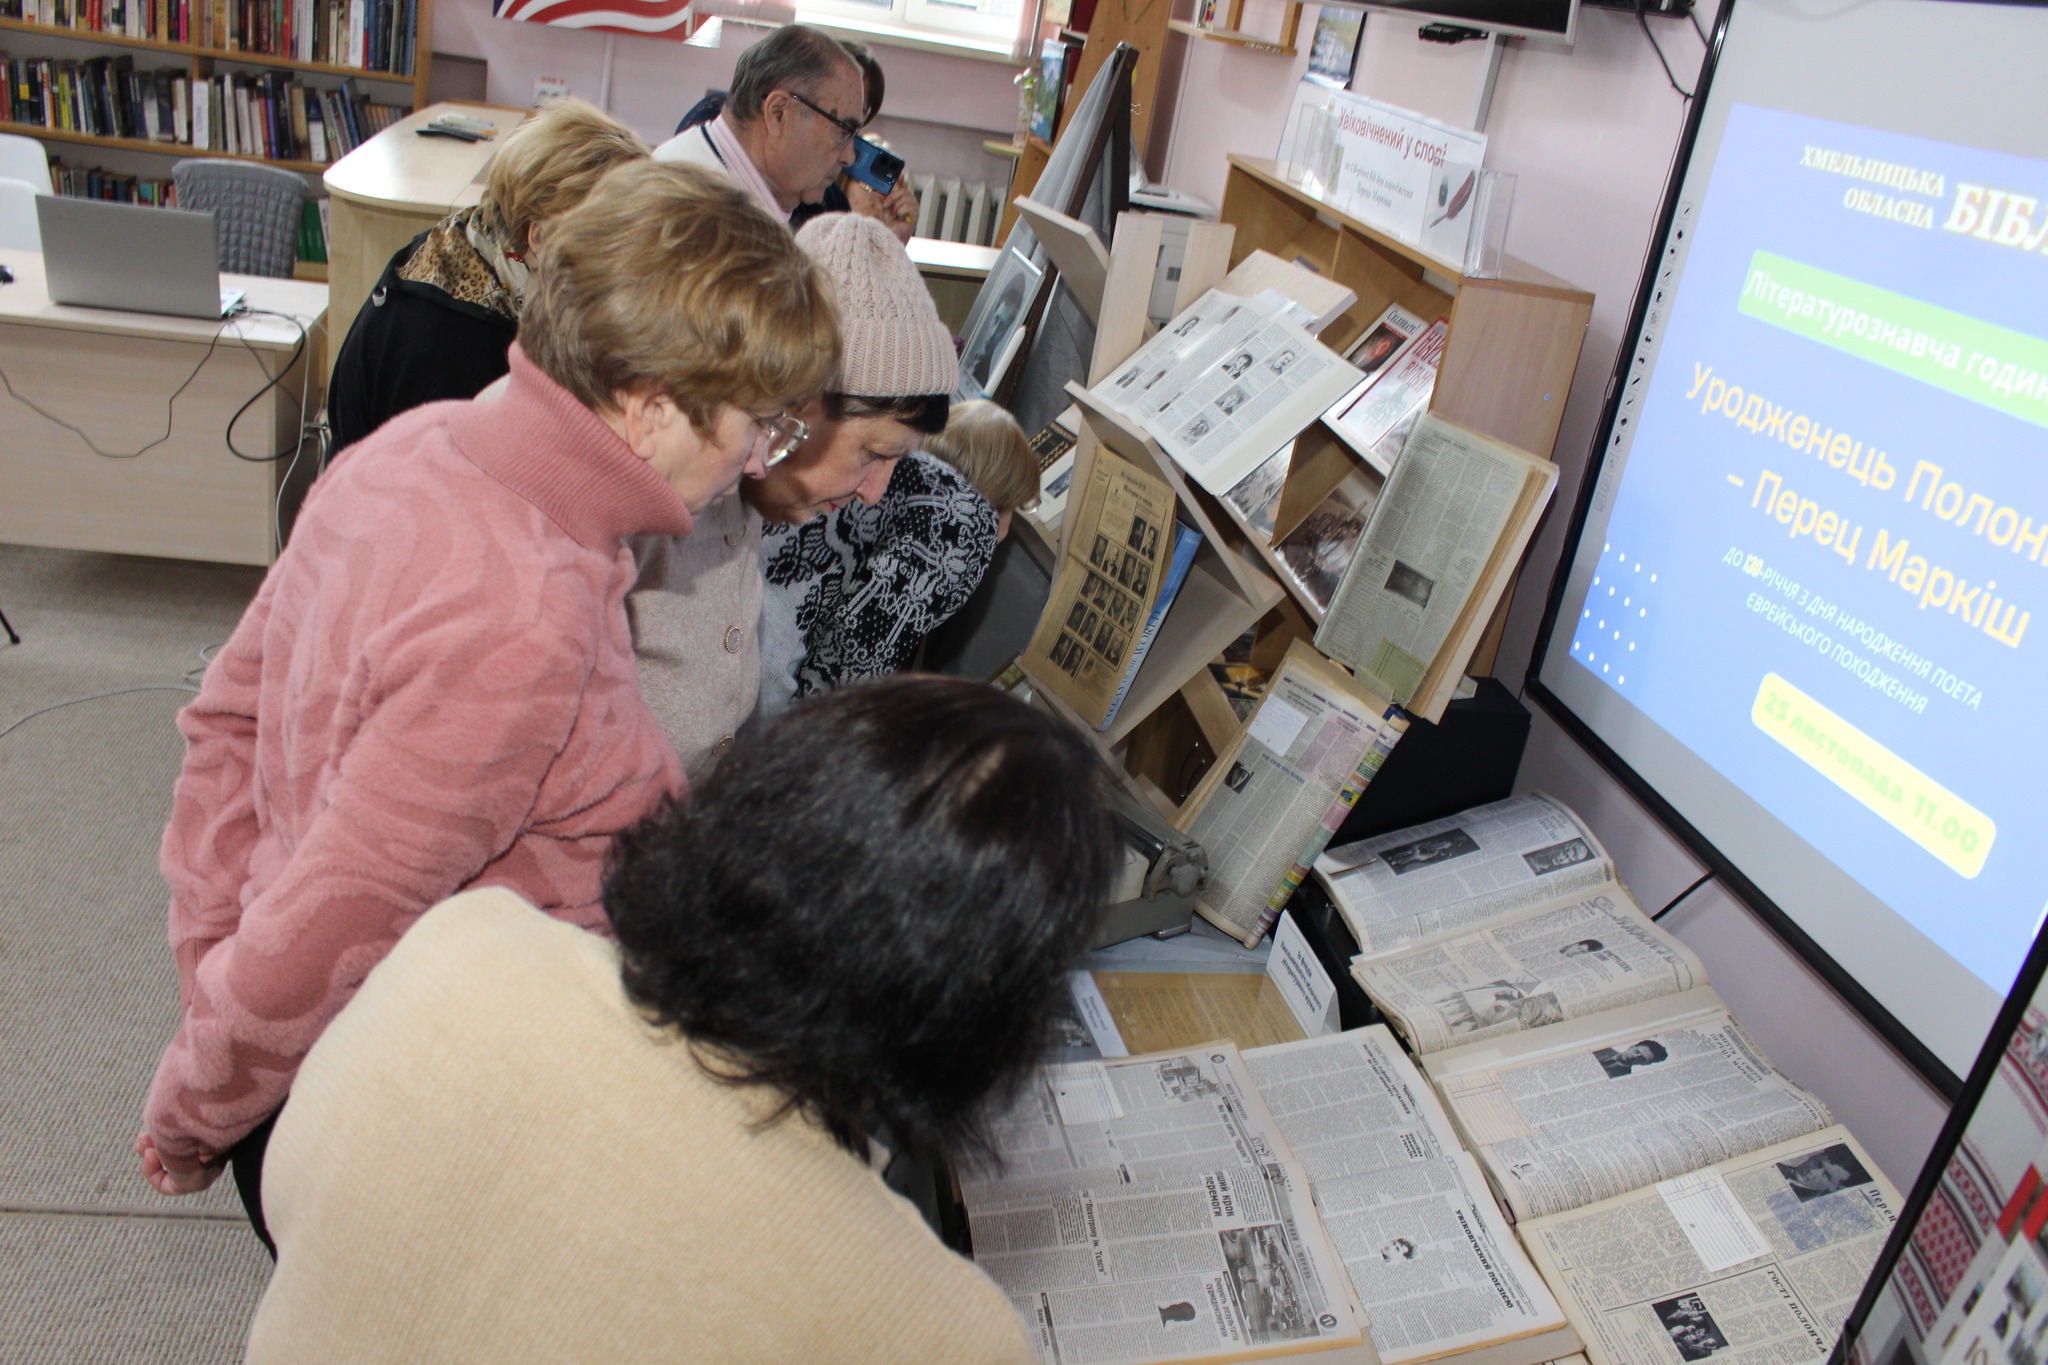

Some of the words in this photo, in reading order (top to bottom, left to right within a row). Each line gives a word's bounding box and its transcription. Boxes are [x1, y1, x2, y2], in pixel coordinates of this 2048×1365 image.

[1338, 107, 1405, 151] Увіковічнений
[1403, 136, 1413, 160] у
[1414, 139, 1448, 168] слові
[1800, 145, 1945, 197] ХМЕЛЬНИЦЬКА
[1844, 187, 1935, 229] ОБЛАСНА
[1744, 269, 1959, 368] Літературознавча
[1685, 361, 1896, 493] Уродженець
[1750, 470, 1858, 562] Перец
[1866, 529, 2032, 649] Маркіш
[1133, 609, 1161, 656] WORLD
[1721, 546, 1742, 567] ДО
[1807, 594, 1838, 622] ДНЯ
[1834, 603, 1933, 681] НАРОДЖЕННЯ
[1930, 663, 1984, 711] ПОЕТА
[1745, 593, 1832, 655] ЄВРЕЙСЬКОГО
[1829, 640, 1929, 716] ПОХОДЖЕННЯ
[1762, 689, 1789, 721] 25
[1788, 709, 1905, 804] листопада
[1912, 792, 1979, 855] 11.00
[1709, 1033, 1731, 1058] ПЕРЕЦА
[1717, 1032, 1736, 1055] ЖИТТЯ
[1203, 1175, 1223, 1217] перемоги
[1220, 1194, 1235, 1217] крок
[1868, 1187, 1897, 1223] Перец
[1453, 1208, 1493, 1271] УВІКОВІЧЕНИЙ
[1486, 1269, 1514, 1310] ПОЕЗІЄЮ
[1766, 1267, 1791, 1300] ГОСТІ
[1213, 1277, 1228, 1304] Очікують
